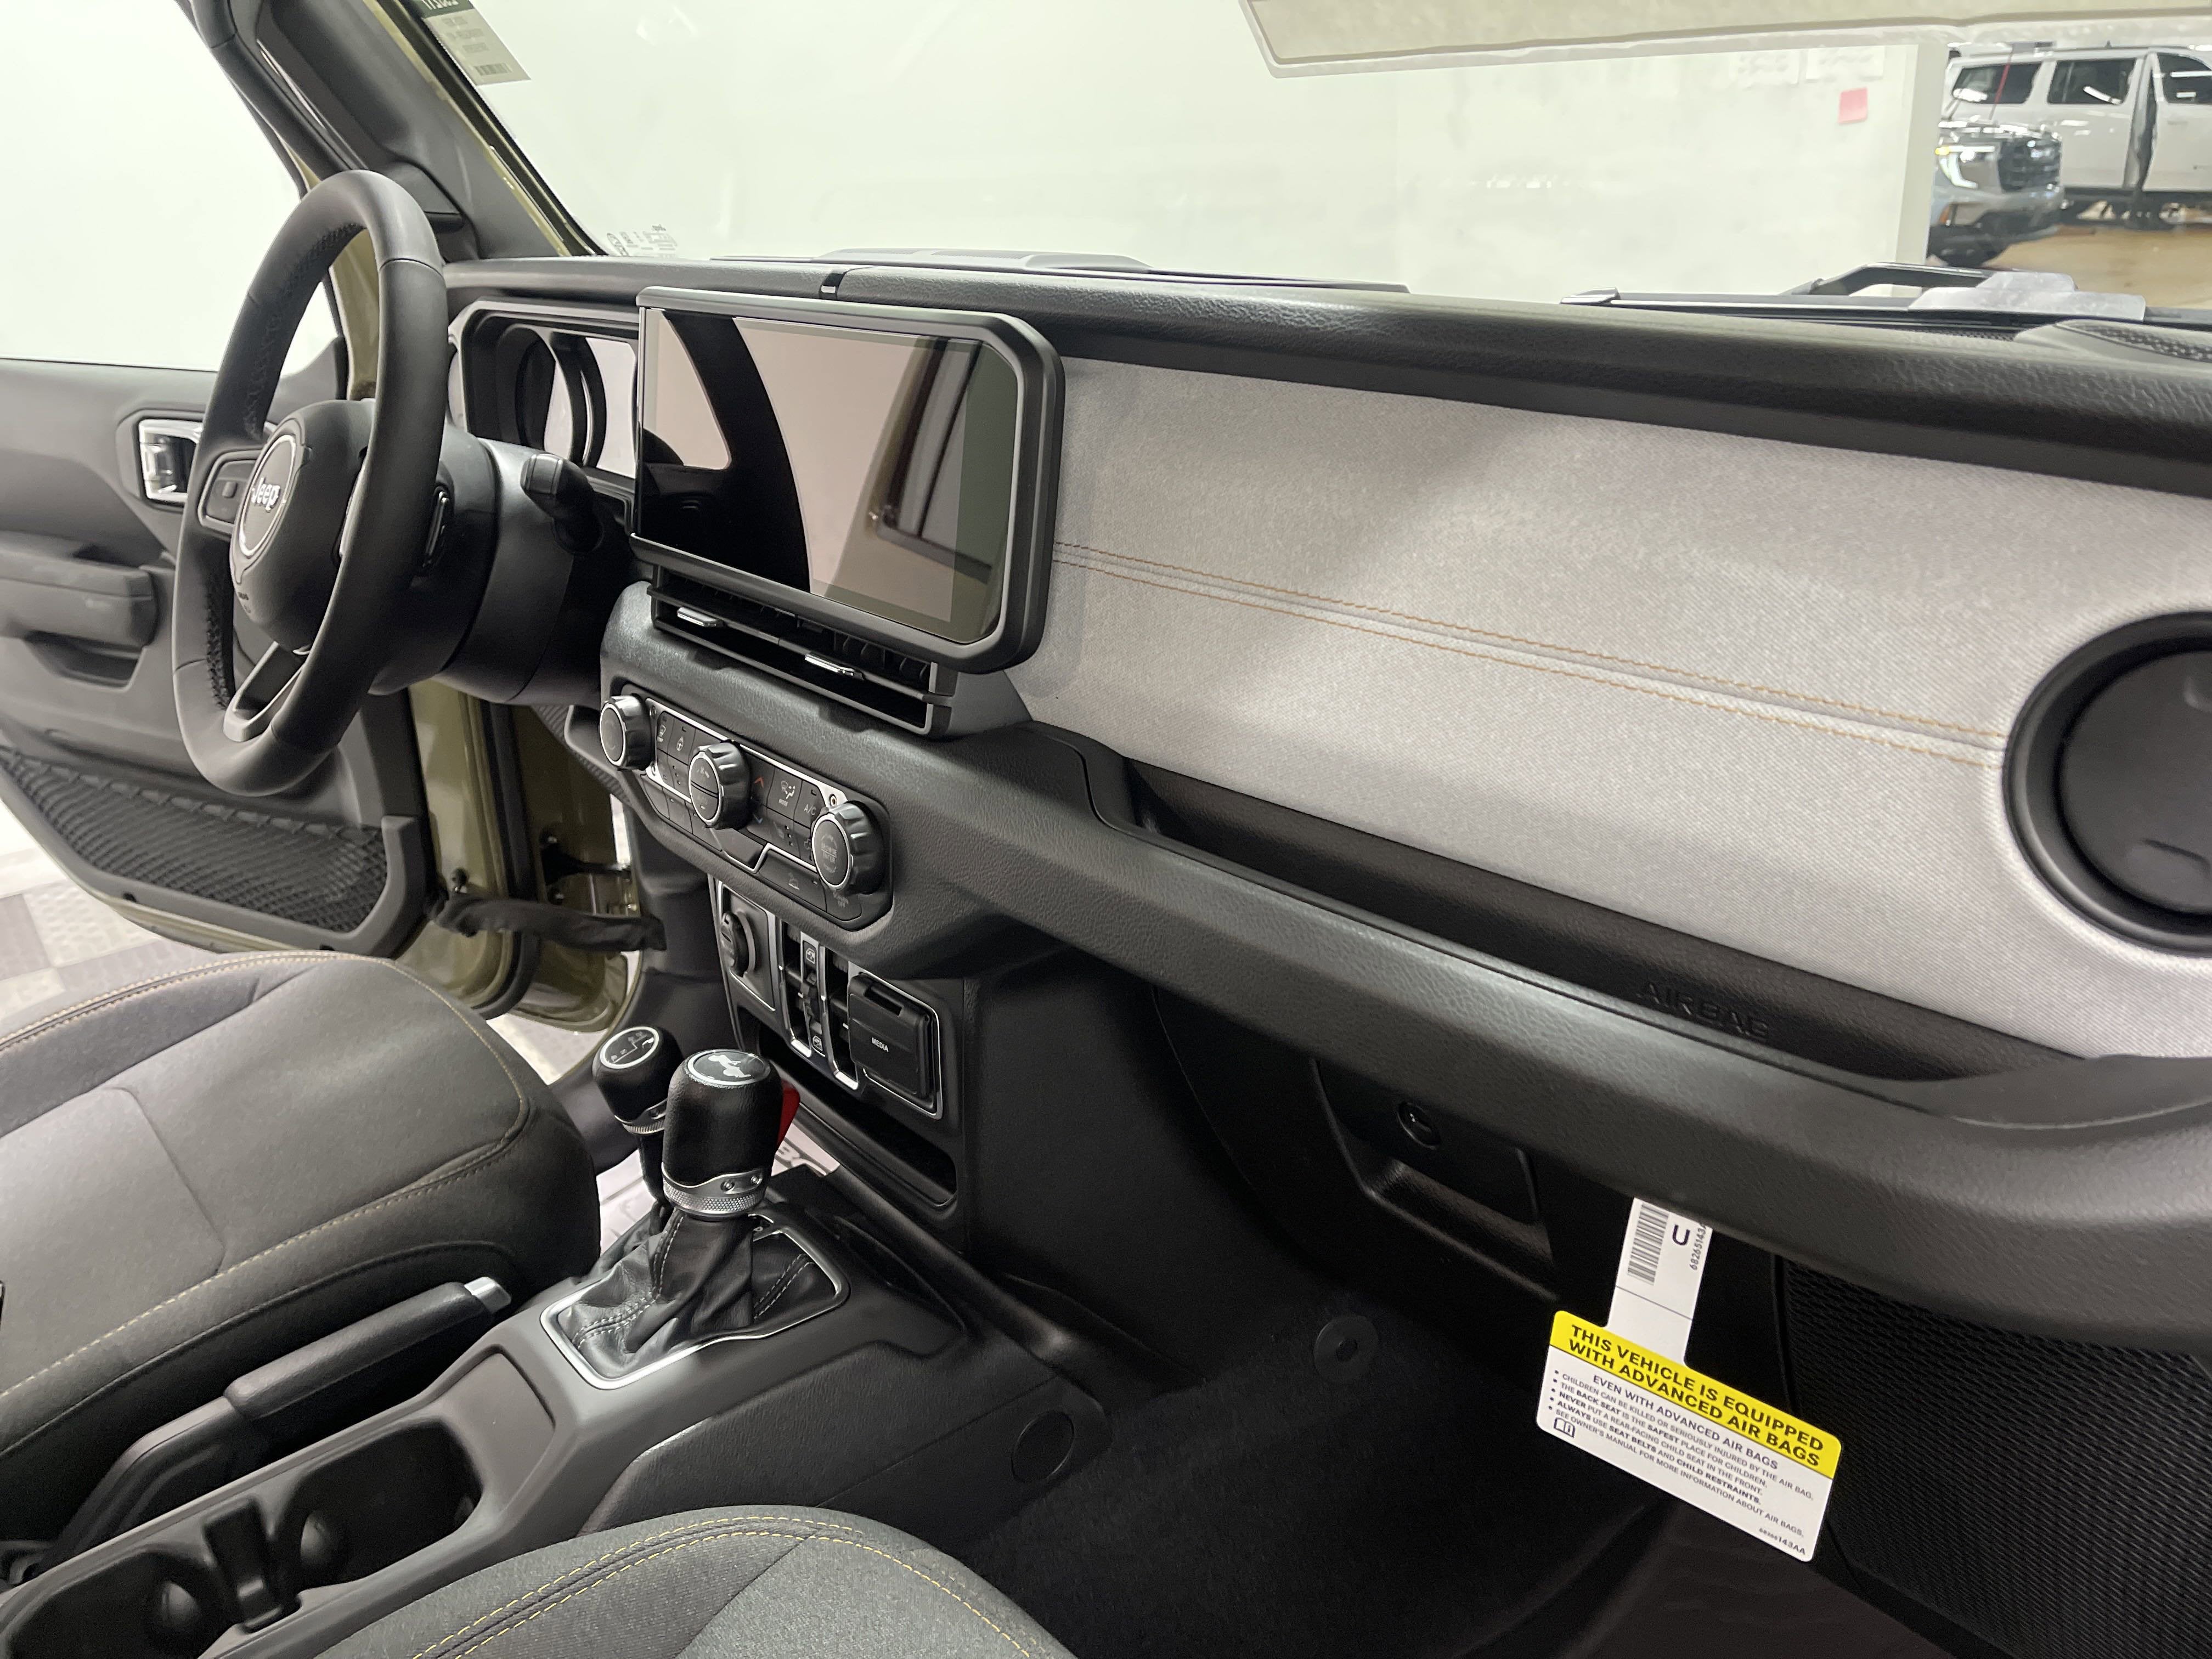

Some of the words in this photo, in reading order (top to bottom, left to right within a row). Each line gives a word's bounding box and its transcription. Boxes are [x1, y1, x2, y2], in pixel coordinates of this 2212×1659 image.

[251, 477, 281, 511] Jeep
[804, 804, 817, 816] A/C
[871, 1036, 889, 1053] MEDIA
[1635, 983, 1770, 1037] AIRBAG
[1672, 1224, 1691, 1246] U
[1562, 1373, 1599, 1395] CHILDREN
[1600, 1391, 1616, 1403] CAN
[1618, 1400, 1627, 1409] BE
[1629, 1405, 1656, 1422] KILLED
[1657, 1419, 1668, 1429] OR
[1670, 1425, 1713, 1449] SERIOUSLY
[1714, 1446, 1747, 1466] INJURED
[1749, 1463, 1760, 1472] BY
[1762, 1469, 1776, 1481] THE
[1779, 1479, 1793, 1489] AIR
[1569, 1338, 1615, 1369] WITH
[1618, 1364, 1723, 1419] ADVANCED
[1727, 1415, 1760, 1438] AIR
[1766, 1432, 1820, 1466] BAGS
[1572, 1324, 1612, 1352] THIS
[1617, 1345, 1695, 1391] VEHICLE
[1700, 1384, 1718, 1401] IS
[1723, 1395, 1823, 1451] EQUIPPED
[1593, 1375, 1622, 1395] EVEN
[1625, 1389, 1654, 1410] WITH
[1656, 1406, 1720, 1441] ADVANCED
[1722, 1438, 1743, 1453] AIR
[1746, 1448, 1778, 1469] BAGS
[1556, 1409, 1568, 1419] SEE
[1571, 1416, 1604, 1437] OWNER'S
[1606, 1433, 1637, 1453] MANUAL
[1639, 1449, 1655, 1462] FOR
[1656, 1458, 1678, 1472] MORE
[1680, 1470, 1734, 1501] INFORMATION
[1735, 1498, 1764, 1516] ABOUT
[1764, 1513, 1779, 1524] AIR
[1557, 1401, 1591, 1420] ALWAYS
[1593, 1417, 1607, 1429] USE
[1609, 1425, 1629, 1439] SEAT
[1632, 1436, 1656, 1452] BELTS
[1657, 1449, 1675, 1461] AND
[1677, 1459, 1703, 1475] CHILD
[1559, 1391, 1586, 1408] NEVER
[1587, 1404, 1602, 1416] PUT
[1610, 1415, 1659, 1444] REAR-FACING
[1661, 1441, 1684, 1456] CHILD
[1686, 1453, 1705, 1466] SEAT
[1707, 1463, 1716, 1471] IN
[1718, 1468, 1733, 1480] THE
[1735, 1476, 1763, 1496] FRONT.
[1561, 1382, 1575, 1393] THE
[1576, 1390, 1599, 1405] BACK
[1600, 1402, 1621, 1414] SEAT
[1632, 1415, 1645, 1427] THE
[1647, 1424, 1679, 1443] SAFEST
[1680, 1440, 1705, 1457] PLACE
[1707, 1453, 1723, 1465] FOR
[1725, 1462, 1767, 1488] CHILDREN.
